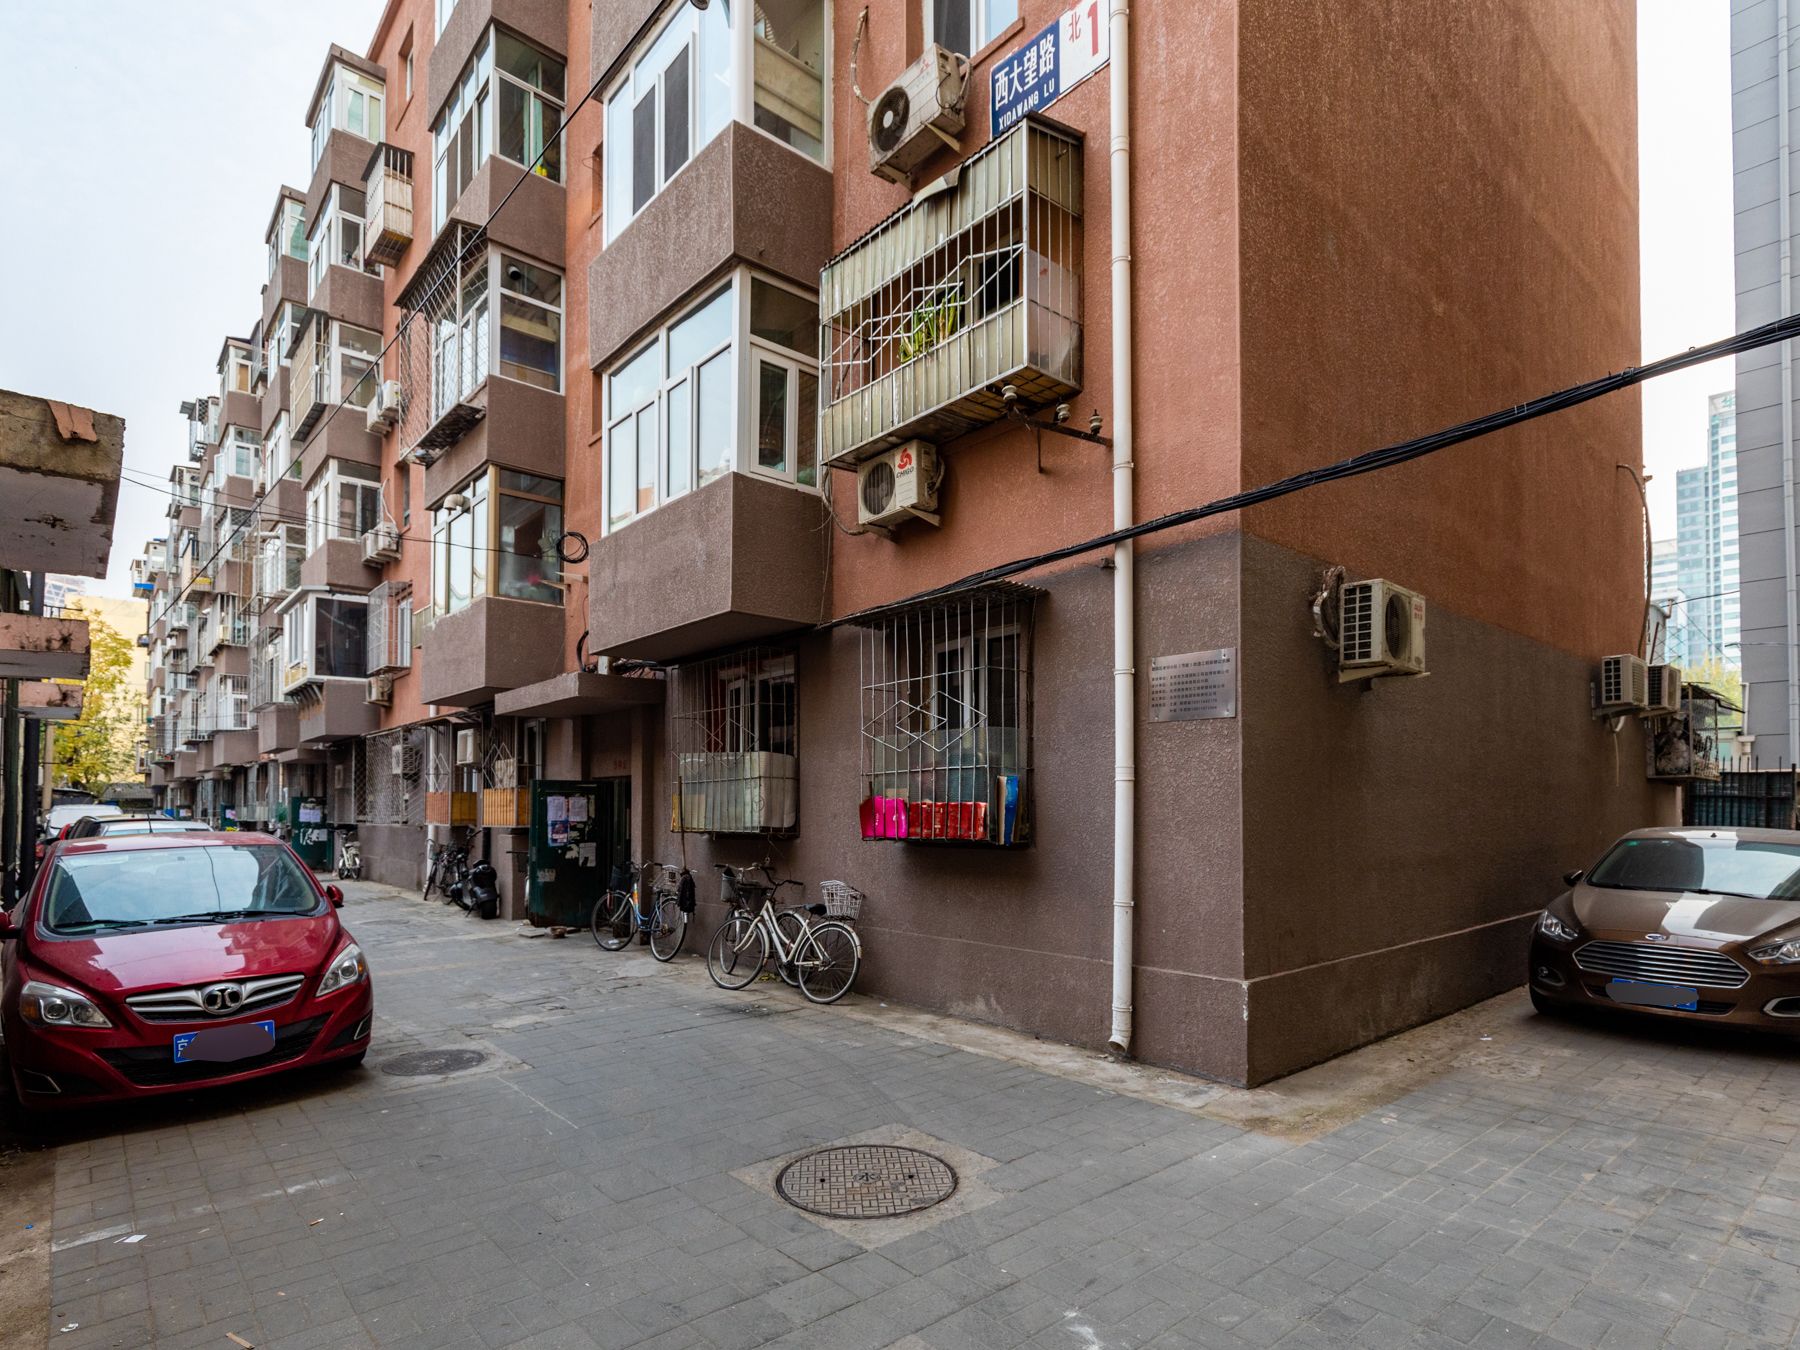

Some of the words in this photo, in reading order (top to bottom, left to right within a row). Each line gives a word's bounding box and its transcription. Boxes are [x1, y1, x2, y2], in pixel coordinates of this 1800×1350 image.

[1069, 11, 1081, 43] 北
[1087, 0, 1099, 57] 1
[995, 33, 1055, 111] 西大望路
[998, 90, 1039, 131] XIDAWANG
[1043, 77, 1055, 98] LU
